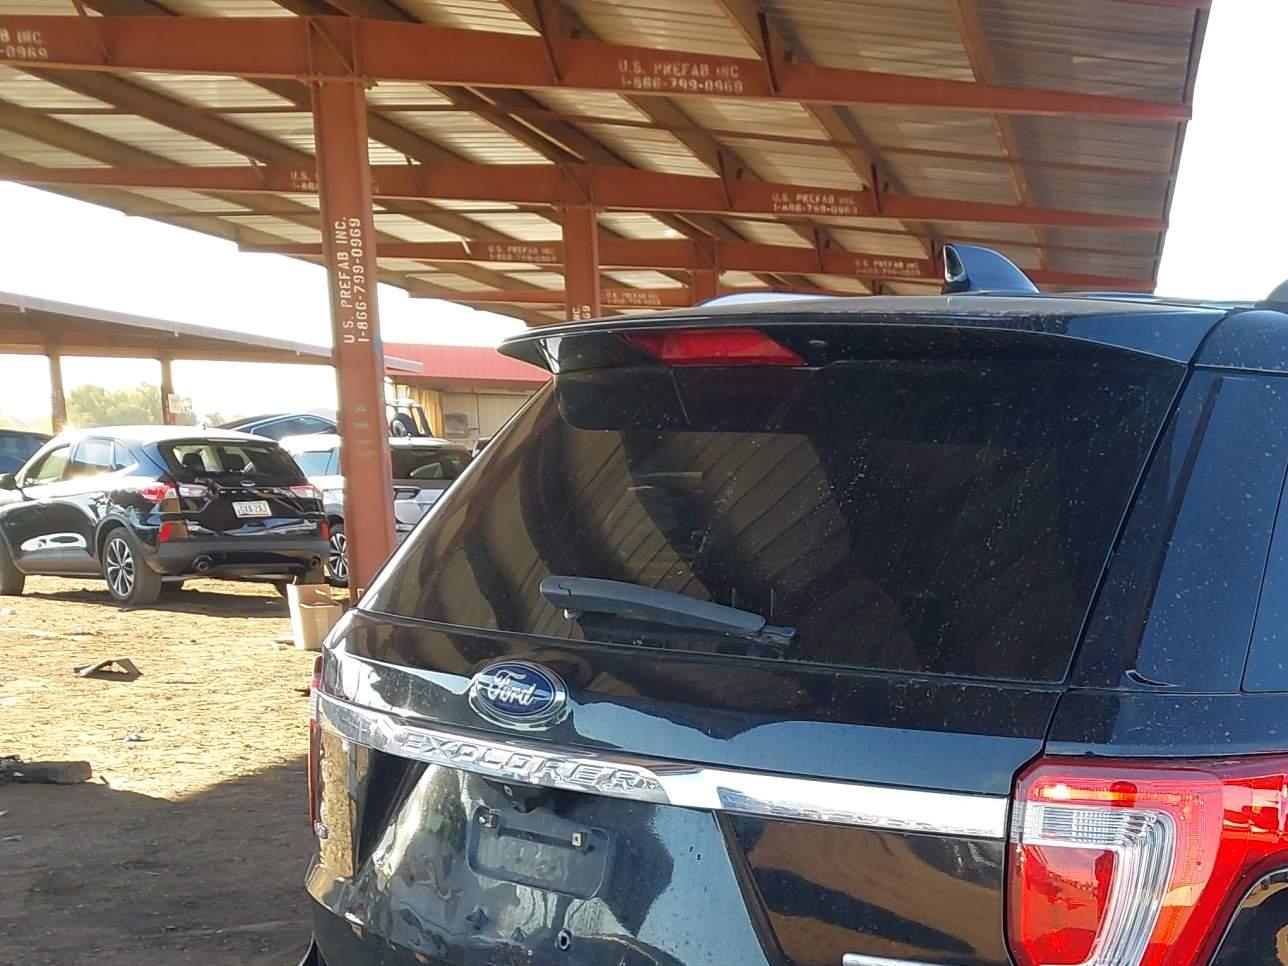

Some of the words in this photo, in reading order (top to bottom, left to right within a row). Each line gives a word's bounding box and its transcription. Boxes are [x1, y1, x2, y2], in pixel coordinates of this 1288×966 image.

[619, 60, 646, 74] U.S.
[653, 62, 709, 77] PREFAB
[334, 216, 348, 245] INC.
[336, 251, 353, 308] PREFAB
[348, 217, 370, 343] 1-866-799-0969
[487, 669, 538, 706] Ford
[401, 733, 648, 791] EXPLORER
